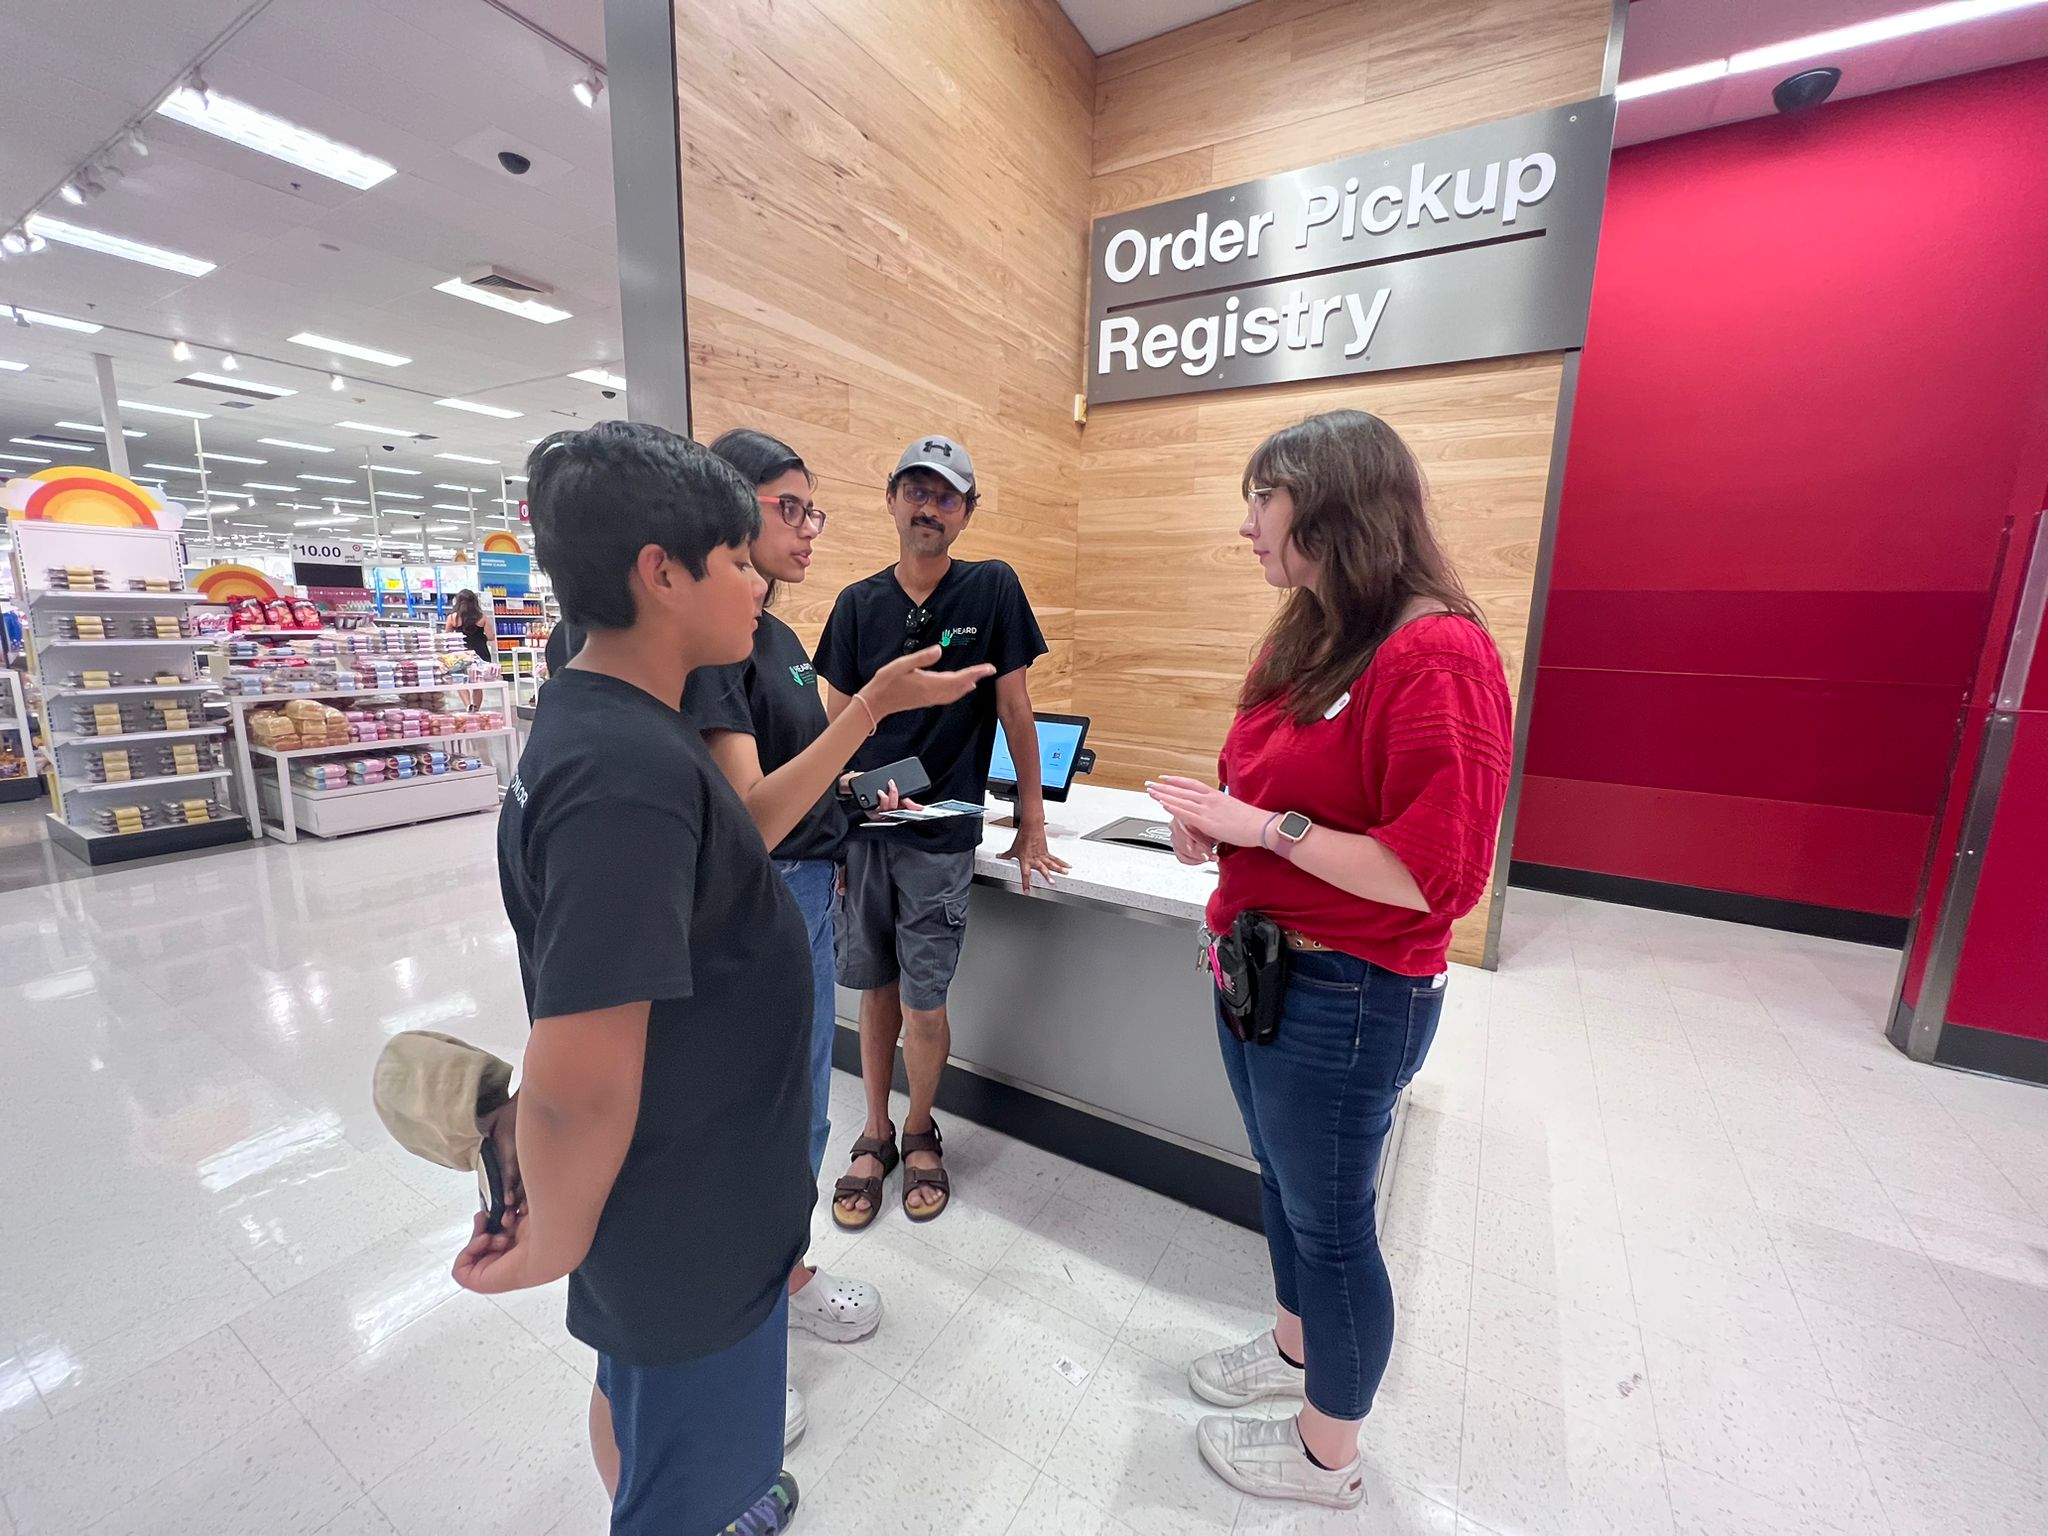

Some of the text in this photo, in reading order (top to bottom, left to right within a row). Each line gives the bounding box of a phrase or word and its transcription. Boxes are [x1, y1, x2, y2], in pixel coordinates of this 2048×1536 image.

[1104, 152, 1556, 283] Order Pickup
[1098, 287, 1392, 376] Registry
[292, 543, 341, 558] $10.00
[952, 626, 977, 635] HEARD
